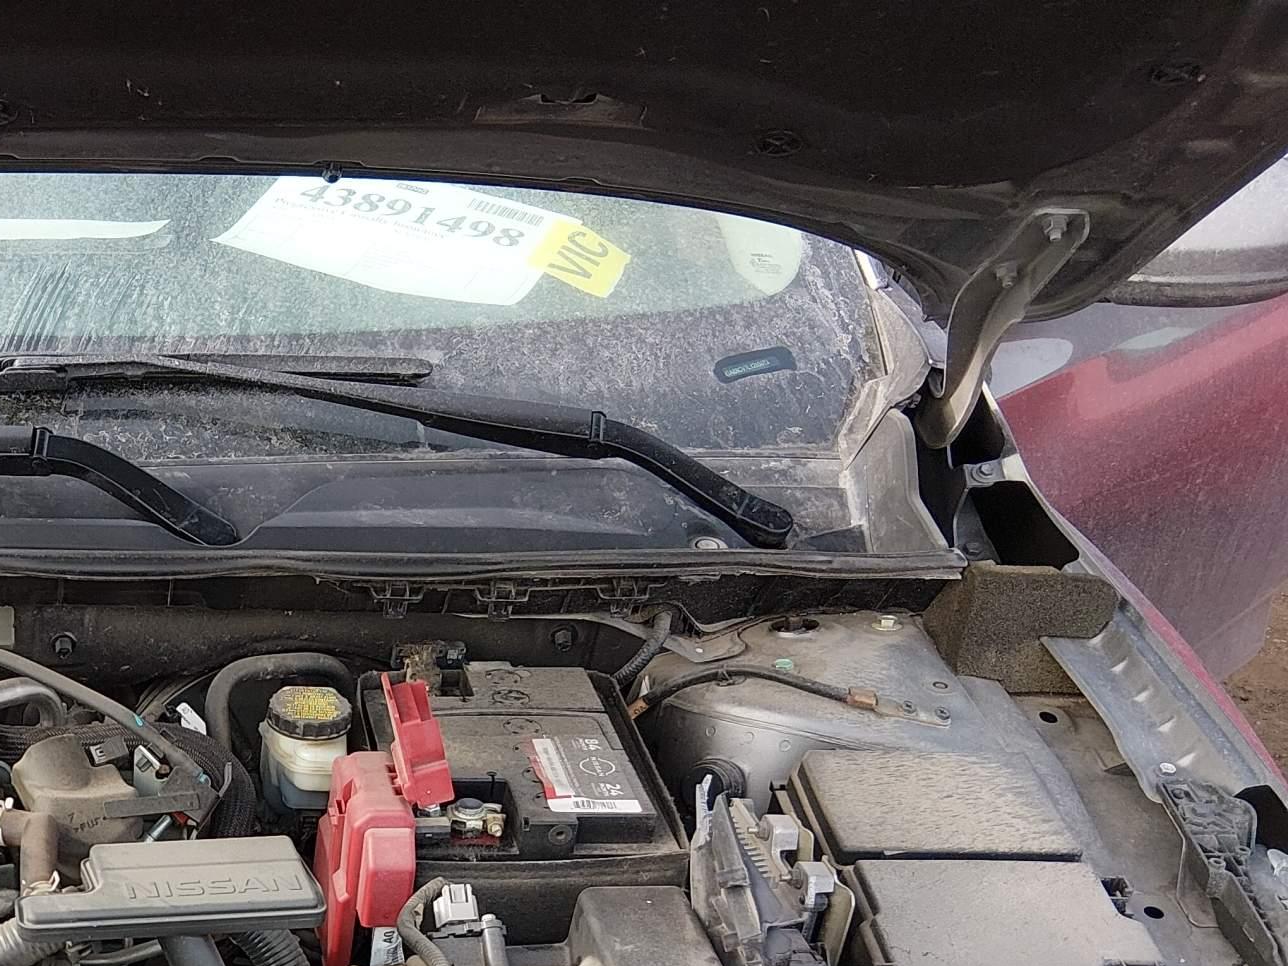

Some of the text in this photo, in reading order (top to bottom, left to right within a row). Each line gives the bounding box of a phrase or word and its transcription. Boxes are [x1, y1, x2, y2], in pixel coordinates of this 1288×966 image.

[299, 183, 527, 247] 43891498
[547, 230, 610, 281] VIC
[125, 873, 303, 900] NISSAN
